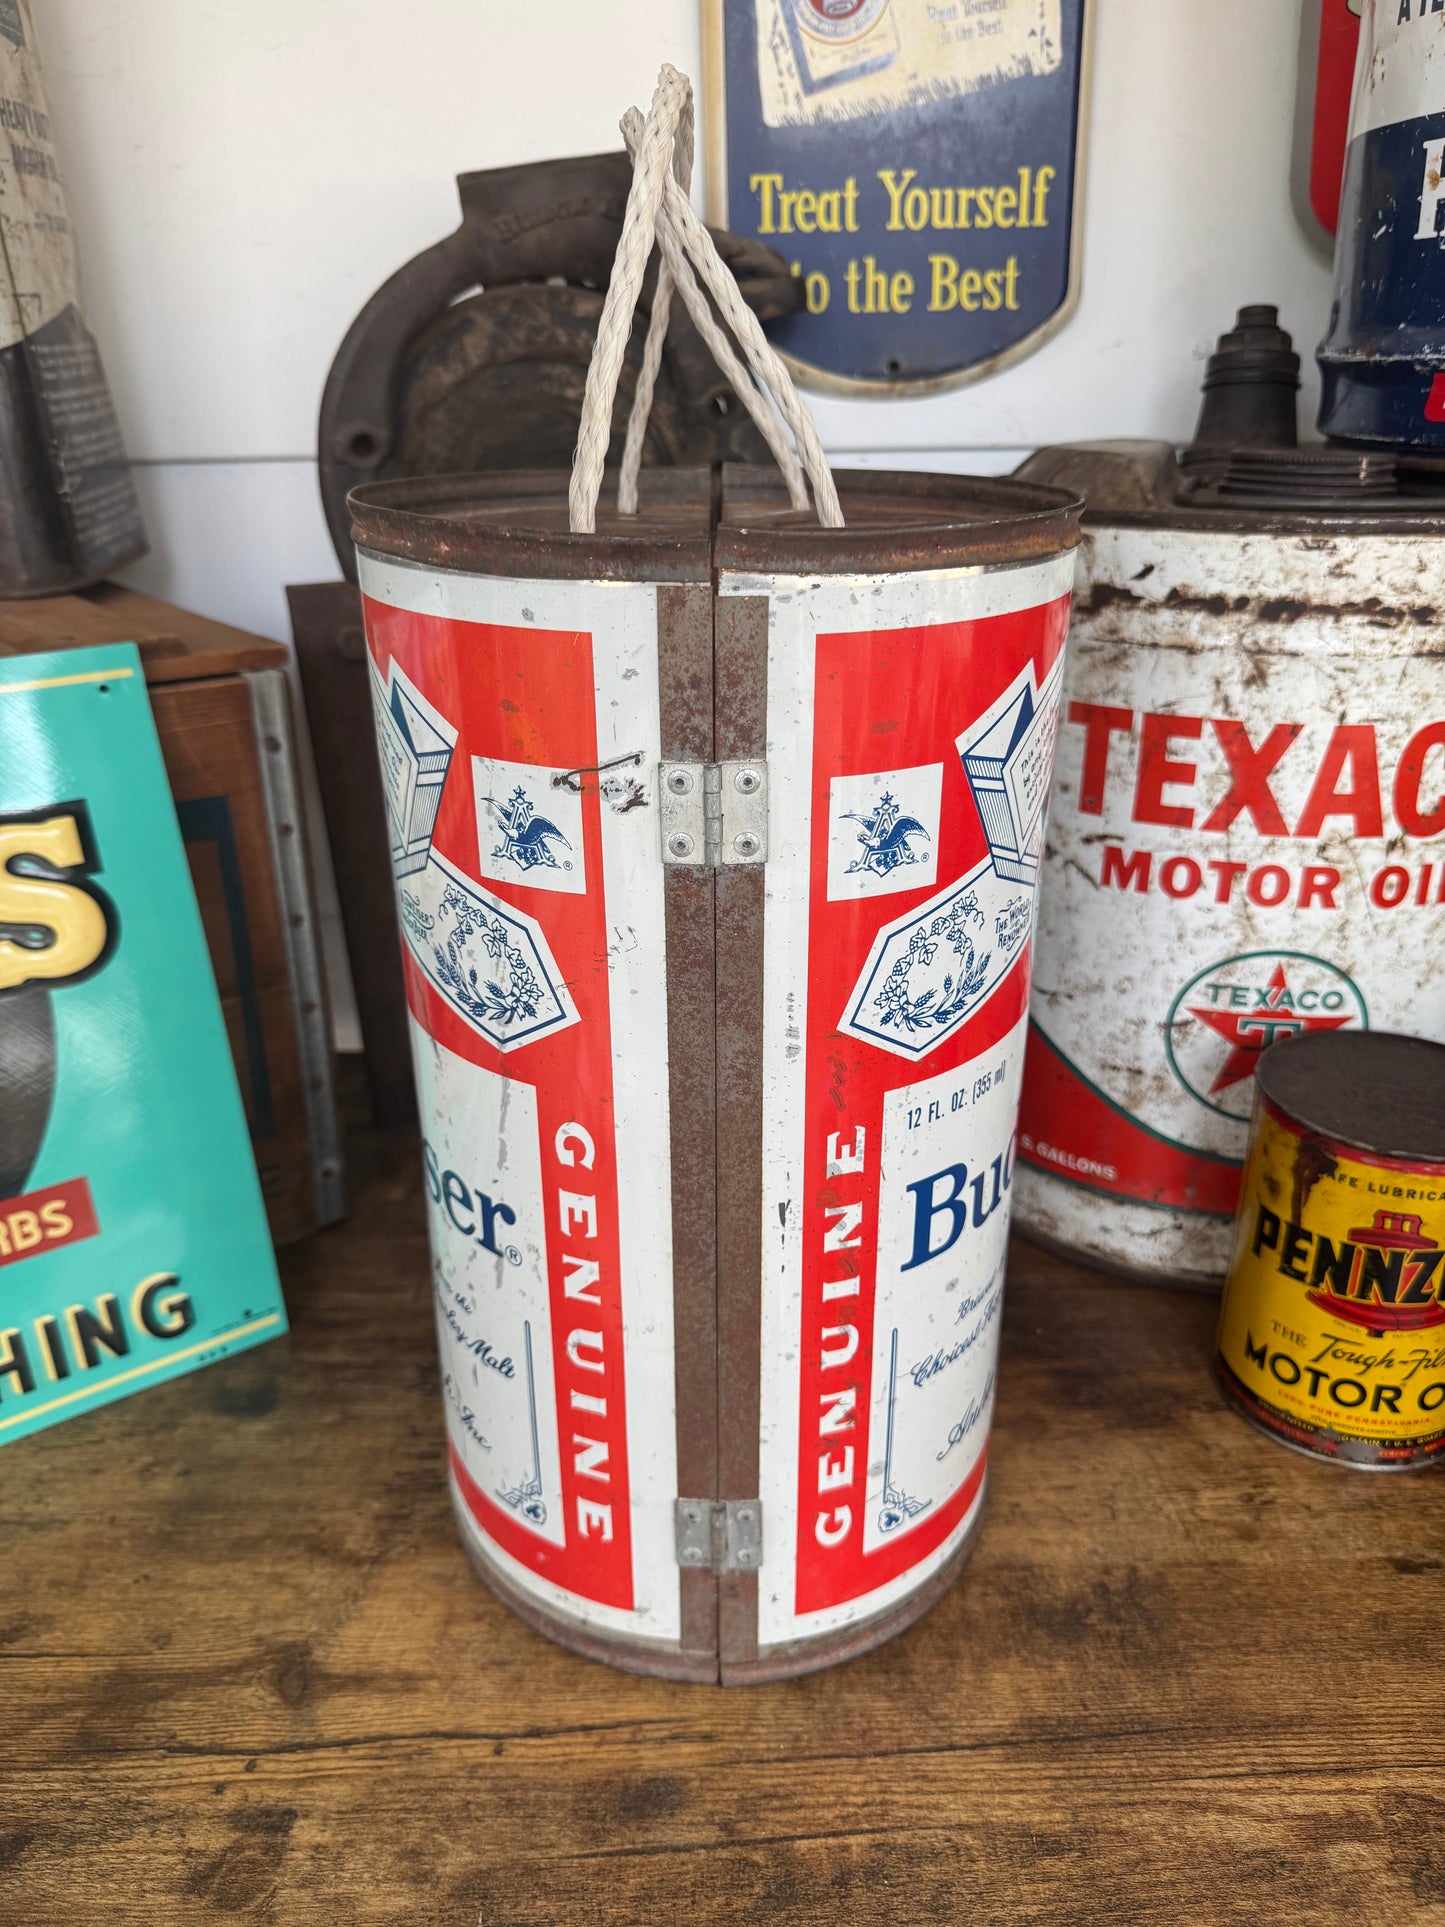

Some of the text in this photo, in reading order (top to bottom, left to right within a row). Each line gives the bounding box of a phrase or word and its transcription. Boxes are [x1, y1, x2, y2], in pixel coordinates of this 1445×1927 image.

[750, 165, 1056, 234] Treat Yourself
[790, 253, 1021, 315] o the Best
[1100, 845, 1340, 911] MOTOR
[995, 917, 1008, 934] THE
[1206, 983, 1344, 1011] TEXACO
[907, 1107, 922, 1130] 12
[928, 1100, 945, 1123] FL.
[951, 1088, 968, 1113] OZ.
[972, 1071, 992, 1105] (355
[1036, 1141, 1118, 1182] GALLONS
[1252, 1202, 1445, 1306] PENNZ
[456, 1292, 473, 1313] the
[554, 1121, 613, 1542] GENUINE
[467, 1338, 516, 1379] Malt
[814, 1124, 866, 1547] GENUINE
[910, 1317, 983, 1388] Choicest
[1270, 1319, 1308, 1348] THE
[1308, 1332, 1445, 1381] Tough-Fil
[1243, 1327, 1402, 1414] MOTOR
